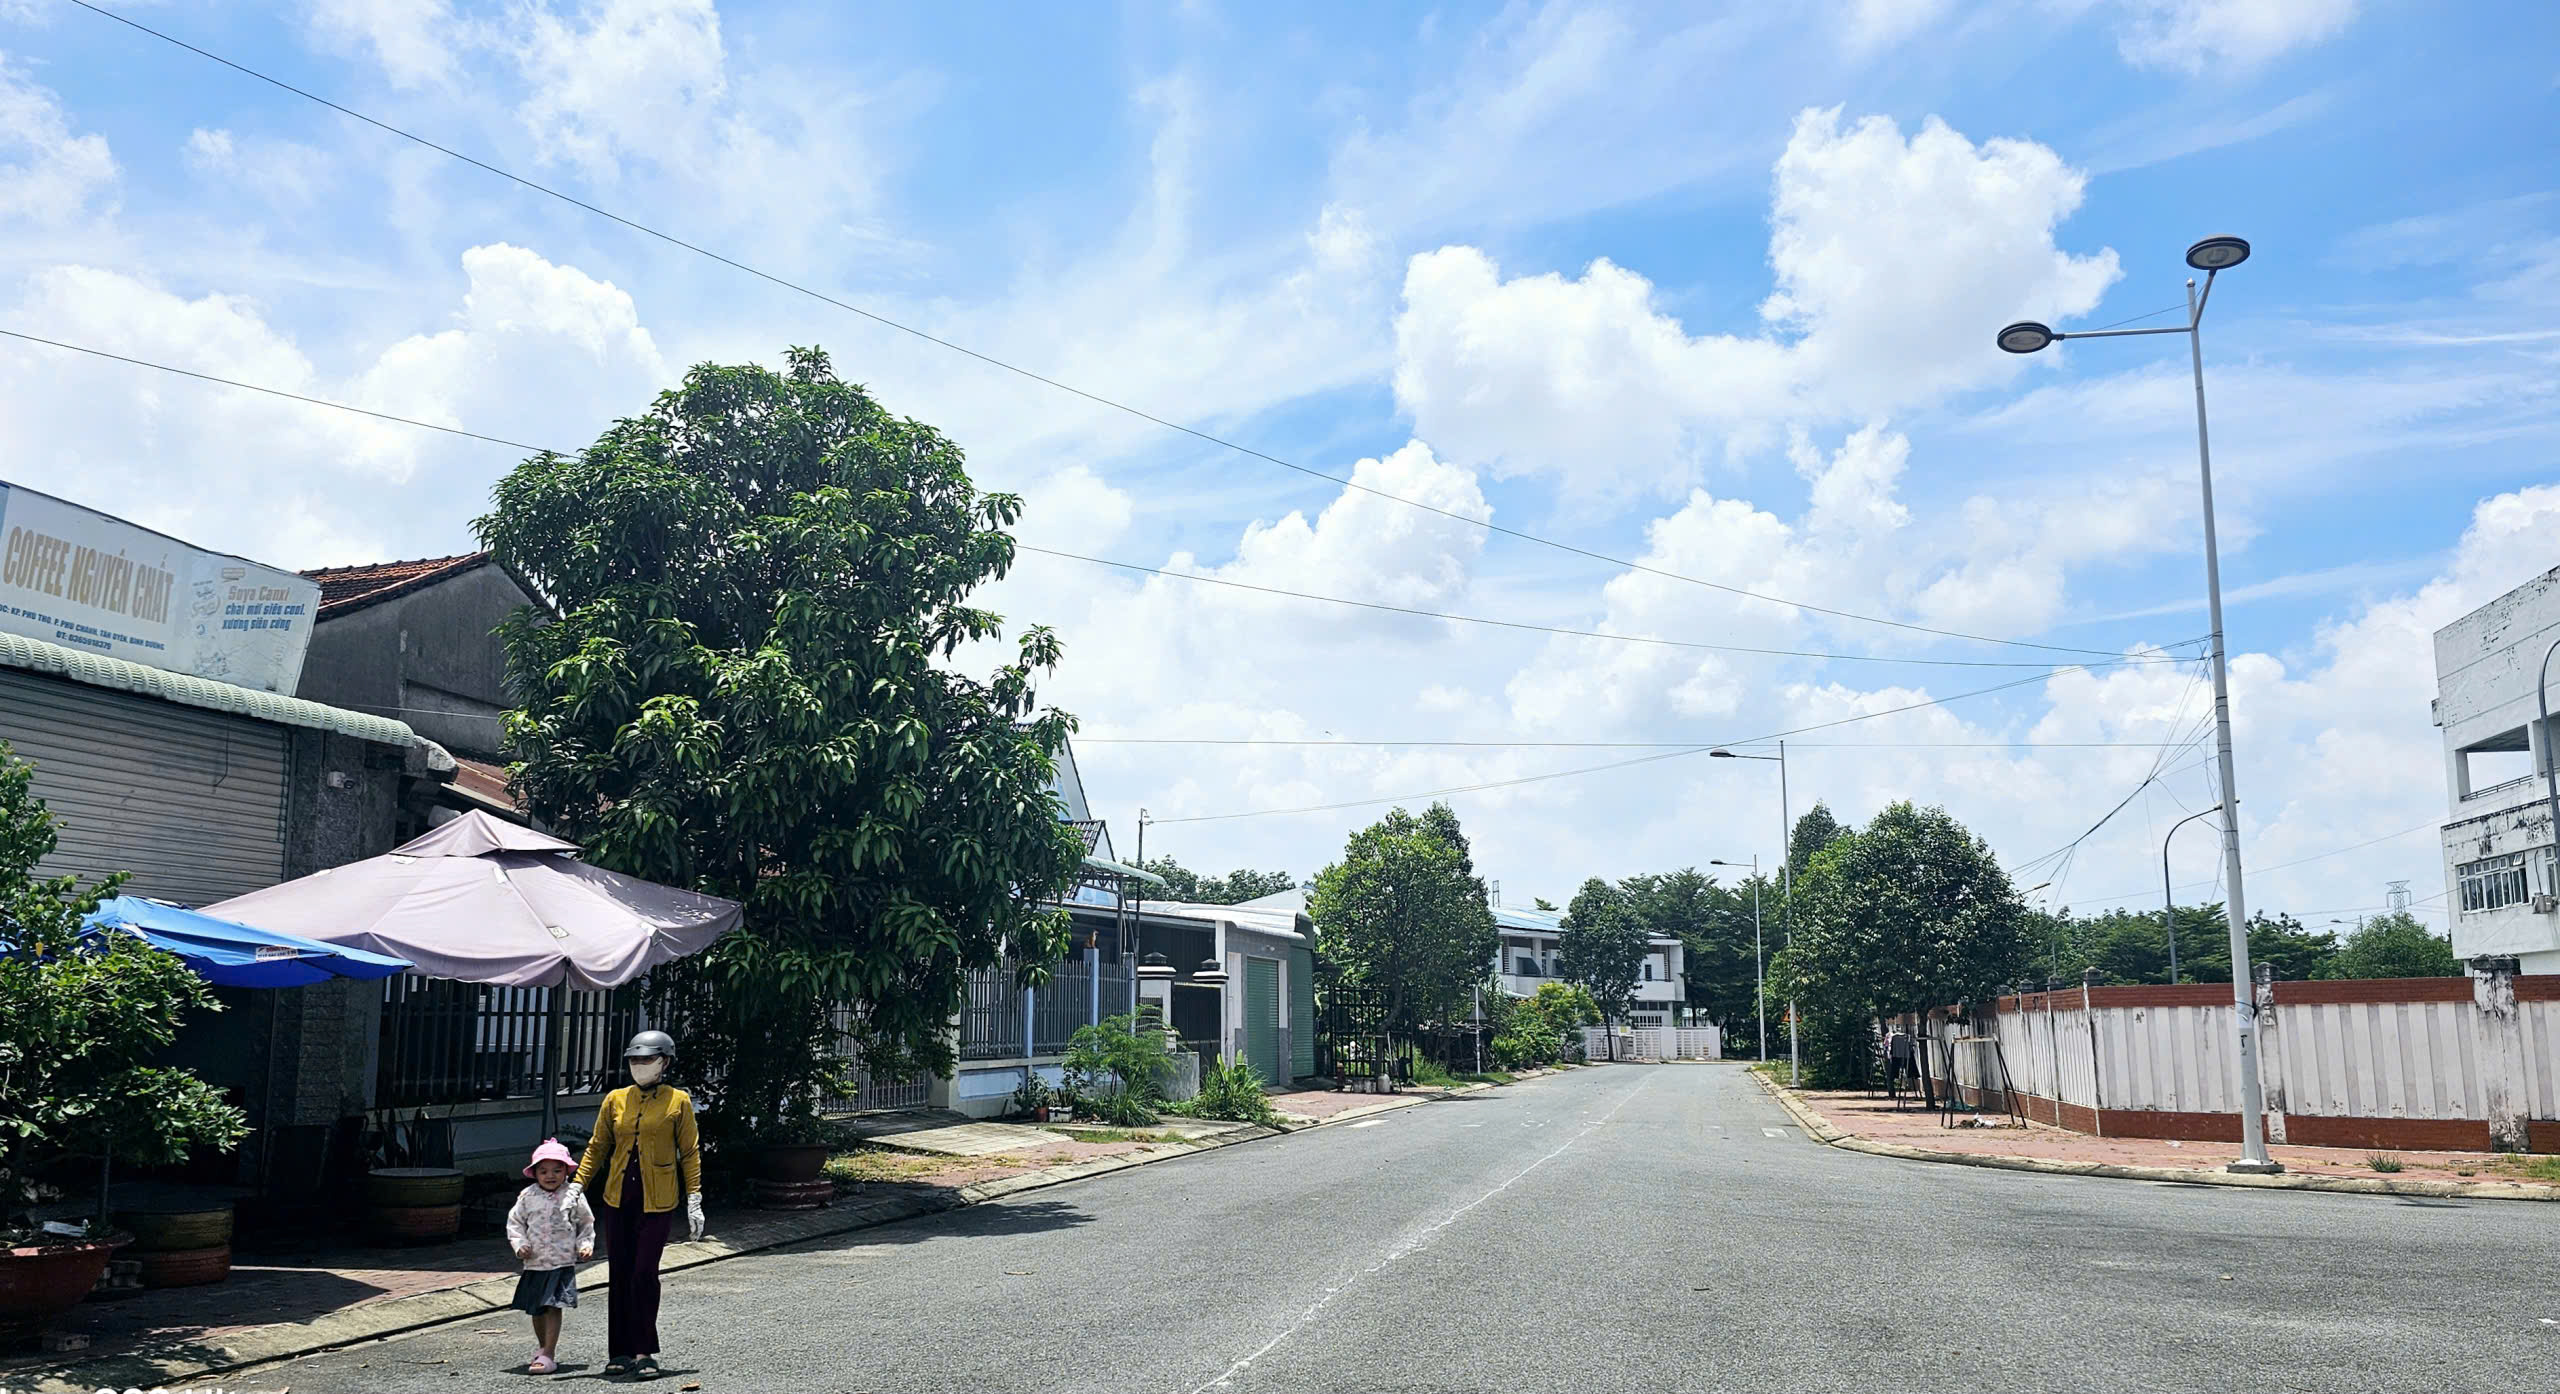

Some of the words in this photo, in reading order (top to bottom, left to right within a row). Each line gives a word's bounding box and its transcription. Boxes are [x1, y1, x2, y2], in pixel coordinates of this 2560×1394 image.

[3, 526, 71, 597] COFFEE
[132, 553, 175, 625] CHẤT
[228, 585, 256, 603] Soya
[258, 586, 290, 601] Canxi
